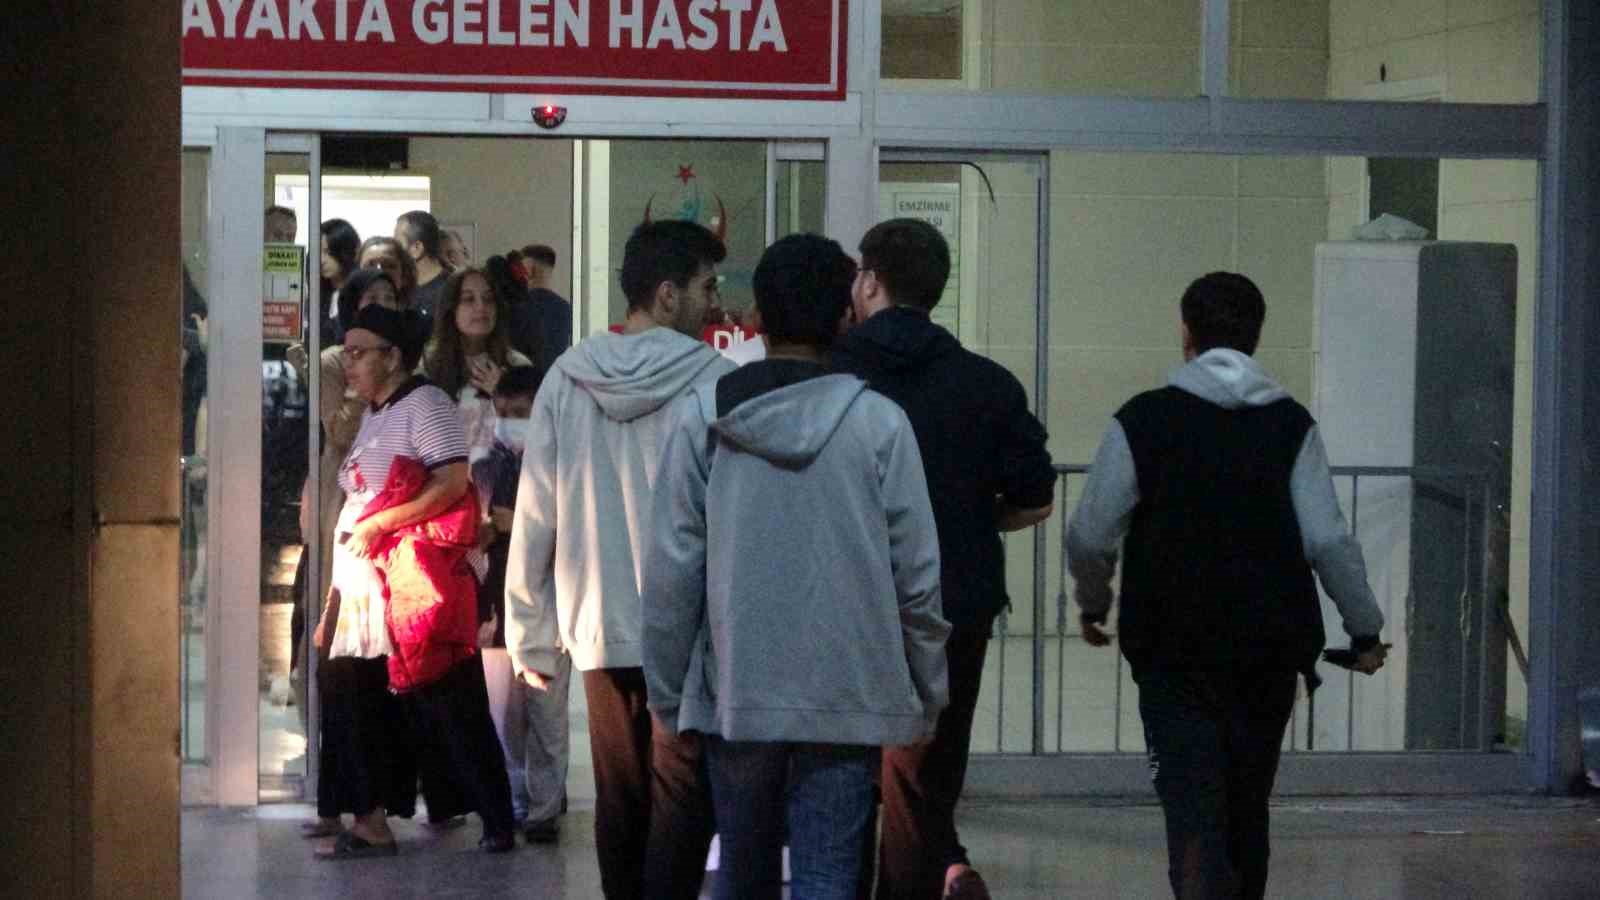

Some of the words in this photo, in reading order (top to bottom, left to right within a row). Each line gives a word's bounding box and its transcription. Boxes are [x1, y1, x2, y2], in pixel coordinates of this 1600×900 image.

[182, 0, 396, 42] AYAKTA
[411, 0, 590, 48] GELEN
[608, 0, 788, 51] HASTA
